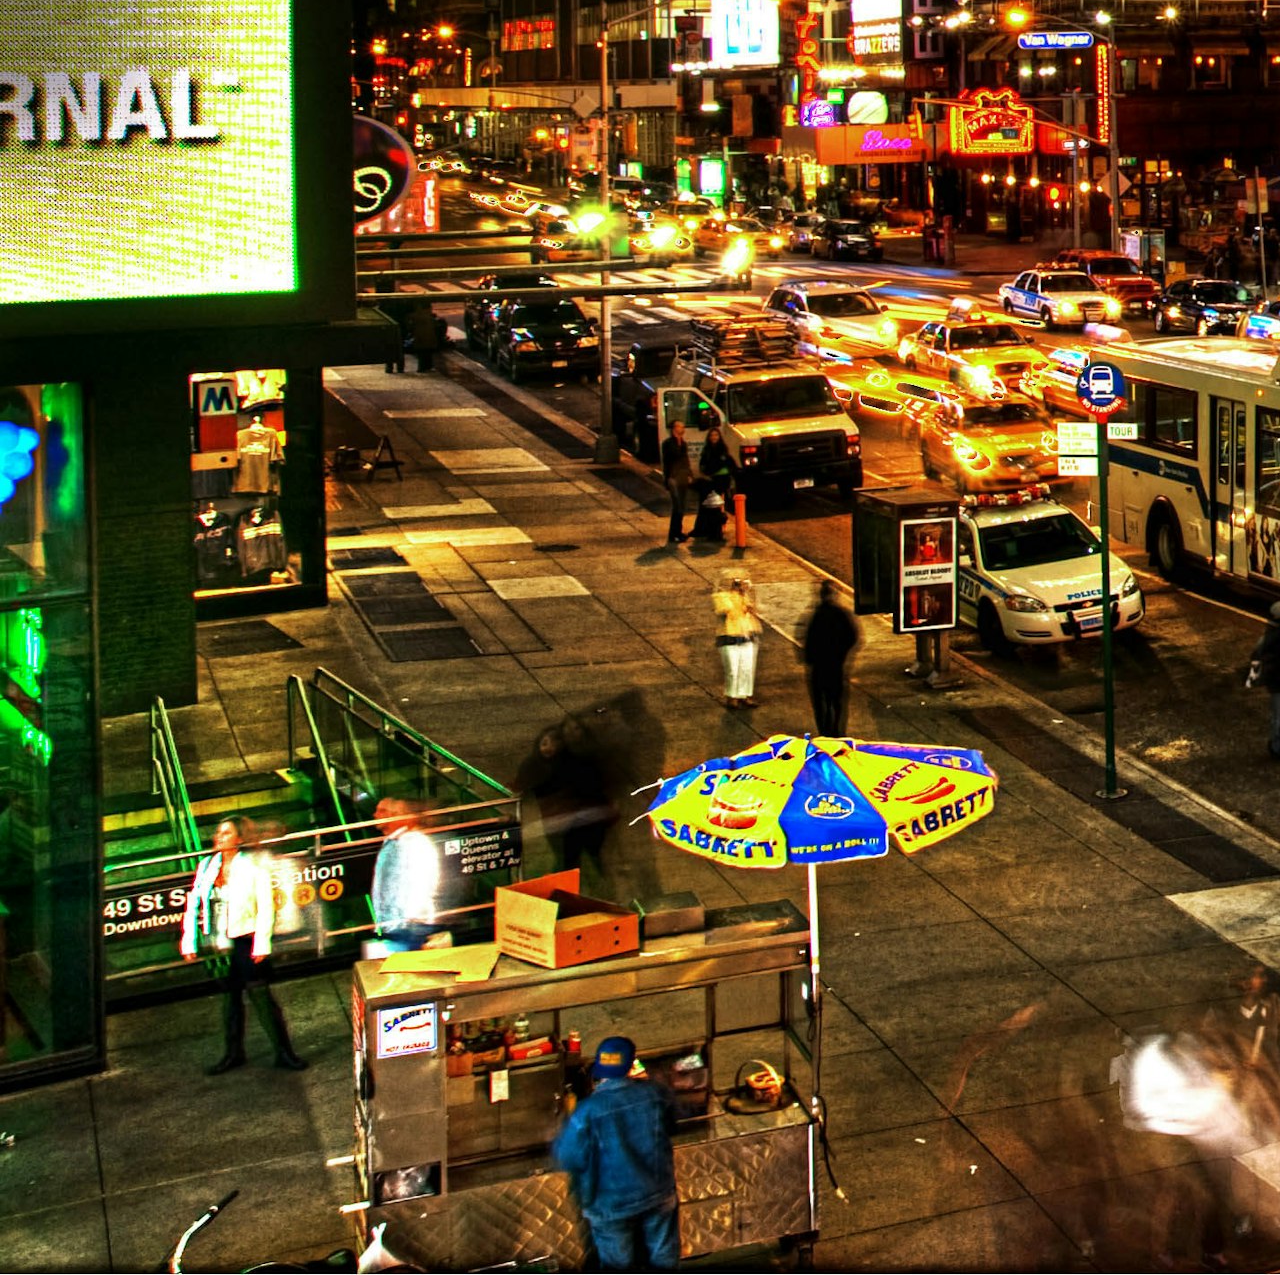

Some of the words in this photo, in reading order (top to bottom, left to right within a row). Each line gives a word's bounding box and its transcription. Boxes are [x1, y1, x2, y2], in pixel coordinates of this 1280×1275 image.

[1022, 32, 1044, 46] Van
[1046, 33, 1090, 49] Wagner
[1110, 426, 1133, 437] TOUR
[869, 761, 921, 803] SABRETT
[895, 784, 998, 842] SABRETT
[460, 834, 500, 848] Uptown
[661, 817, 777, 859] SABRETT
[460, 843, 500, 856] Queens
[460, 853, 503, 865] elevator
[103, 899, 132, 919] 49
[137, 893, 165, 914] St
